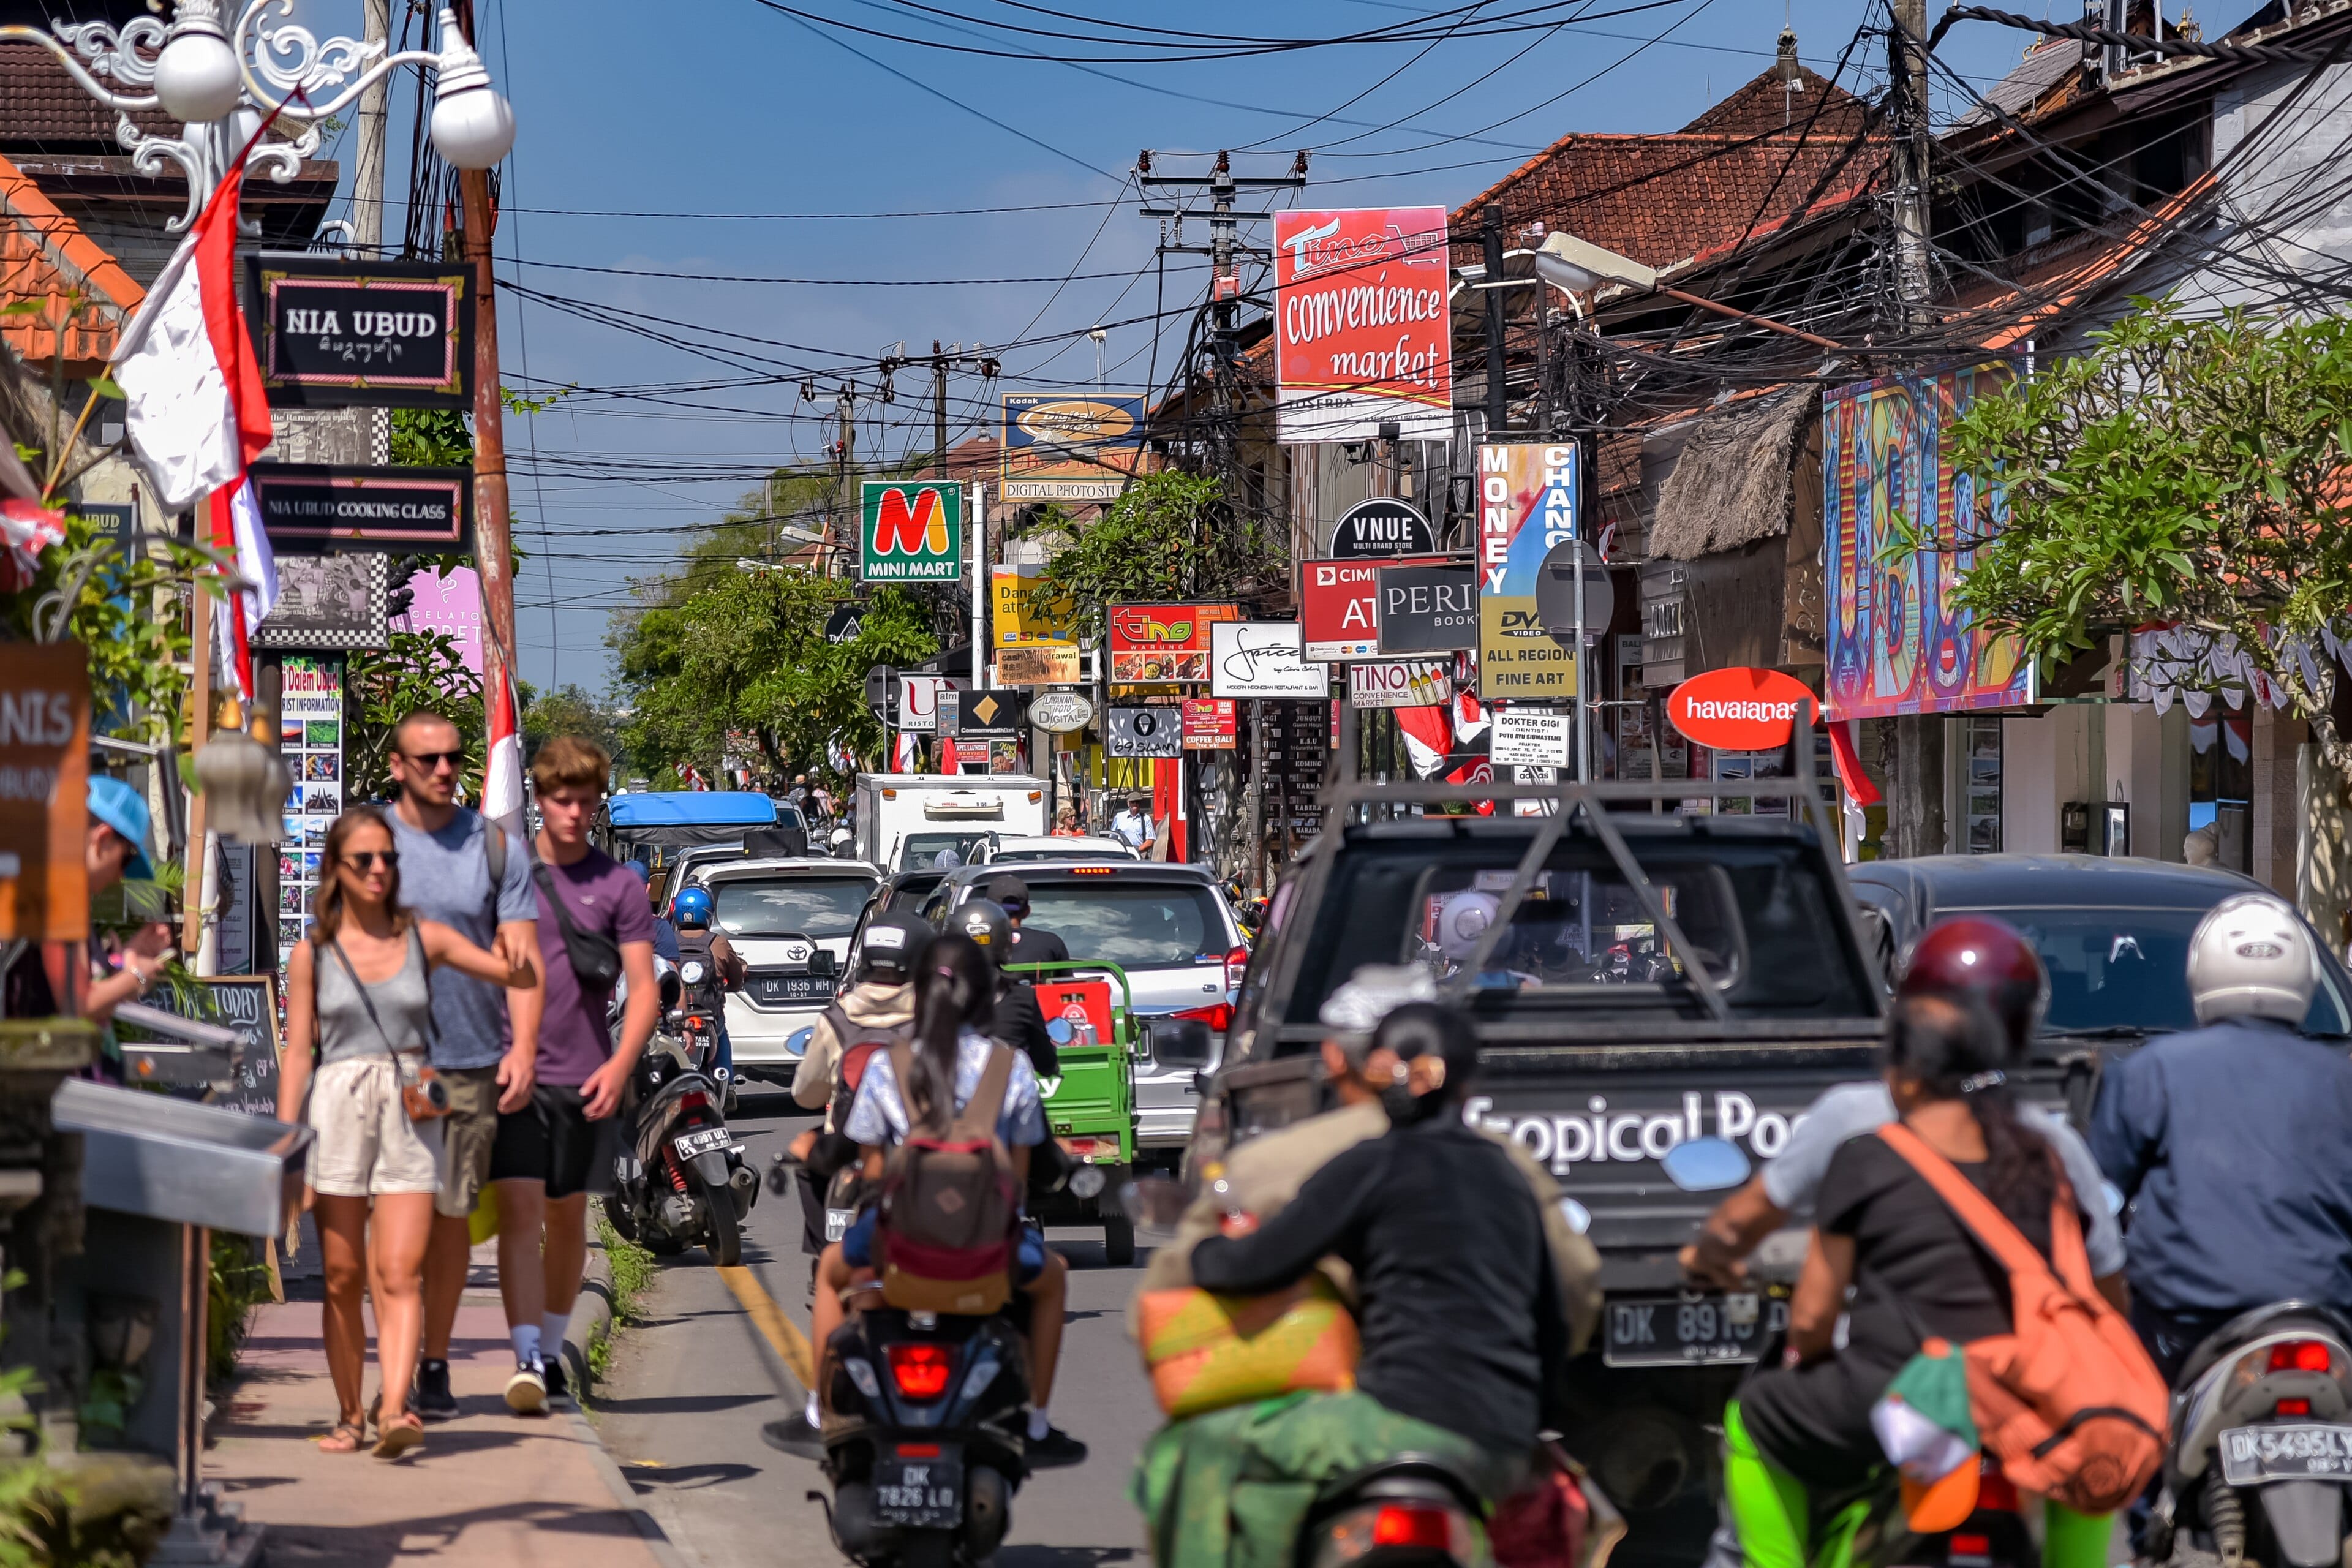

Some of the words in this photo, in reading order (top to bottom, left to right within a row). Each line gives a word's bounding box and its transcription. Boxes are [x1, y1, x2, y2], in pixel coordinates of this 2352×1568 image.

[1283, 217, 1391, 273] Tino
[1287, 270, 1441, 345] convenience
[285, 308, 342, 335] NIA
[352, 311, 437, 337] UBUD
[1330, 334, 1441, 391] market
[1287, 398, 1354, 409] TOSERBA
[1043, 410, 1095, 423] Digital
[1008, 484, 1054, 496] DIGITAL
[1056, 484, 1095, 497] PHOTO
[270, 501, 292, 514] NIA
[294, 501, 335, 515] UBUD
[337, 501, 400, 518] COOKING
[401, 503, 446, 519] CLASS
[1483, 447, 1509, 594] MONEY
[1353, 517, 1413, 541] VNUE
[868, 562, 906, 577] MINI
[908, 562, 955, 577] MART
[412, 610, 480, 621] GELATO
[1434, 615, 1475, 627] BOOK
[1114, 608, 1193, 642] tino
[1487, 649, 1514, 662] ALL
[1518, 649, 1574, 662] REGION
[288, 666, 314, 692] Dalem
[317, 663, 337, 692] Ubud
[1352, 665, 1406, 692] TINO
[1496, 673, 1531, 686] FINE
[1535, 672, 1564, 685] ART
[1044, 696, 1073, 704] LAYANAN
[1353, 691, 1408, 699] CONVENIENCE
[296, 697, 340, 712] INFORMATION
[1039, 710, 1080, 723] DIGITAL
[1501, 718, 1538, 726] DOKTER
[1114, 742, 1135, 753] 69
[1136, 742, 1177, 753] SLAM
[766, 980, 780, 992] DK
[786, 979, 810, 992] 1936
[815, 979, 829, 991] WH
[209, 987, 260, 1019] TODAY
[679, 1137, 693, 1150] DK
[714, 1129, 727, 1140] UL
[829, 1213, 847, 1226] DK
[1613, 1305, 1656, 1344] DK
[2231, 1434, 2263, 1462] DK
[903, 1466, 930, 1487] DK
